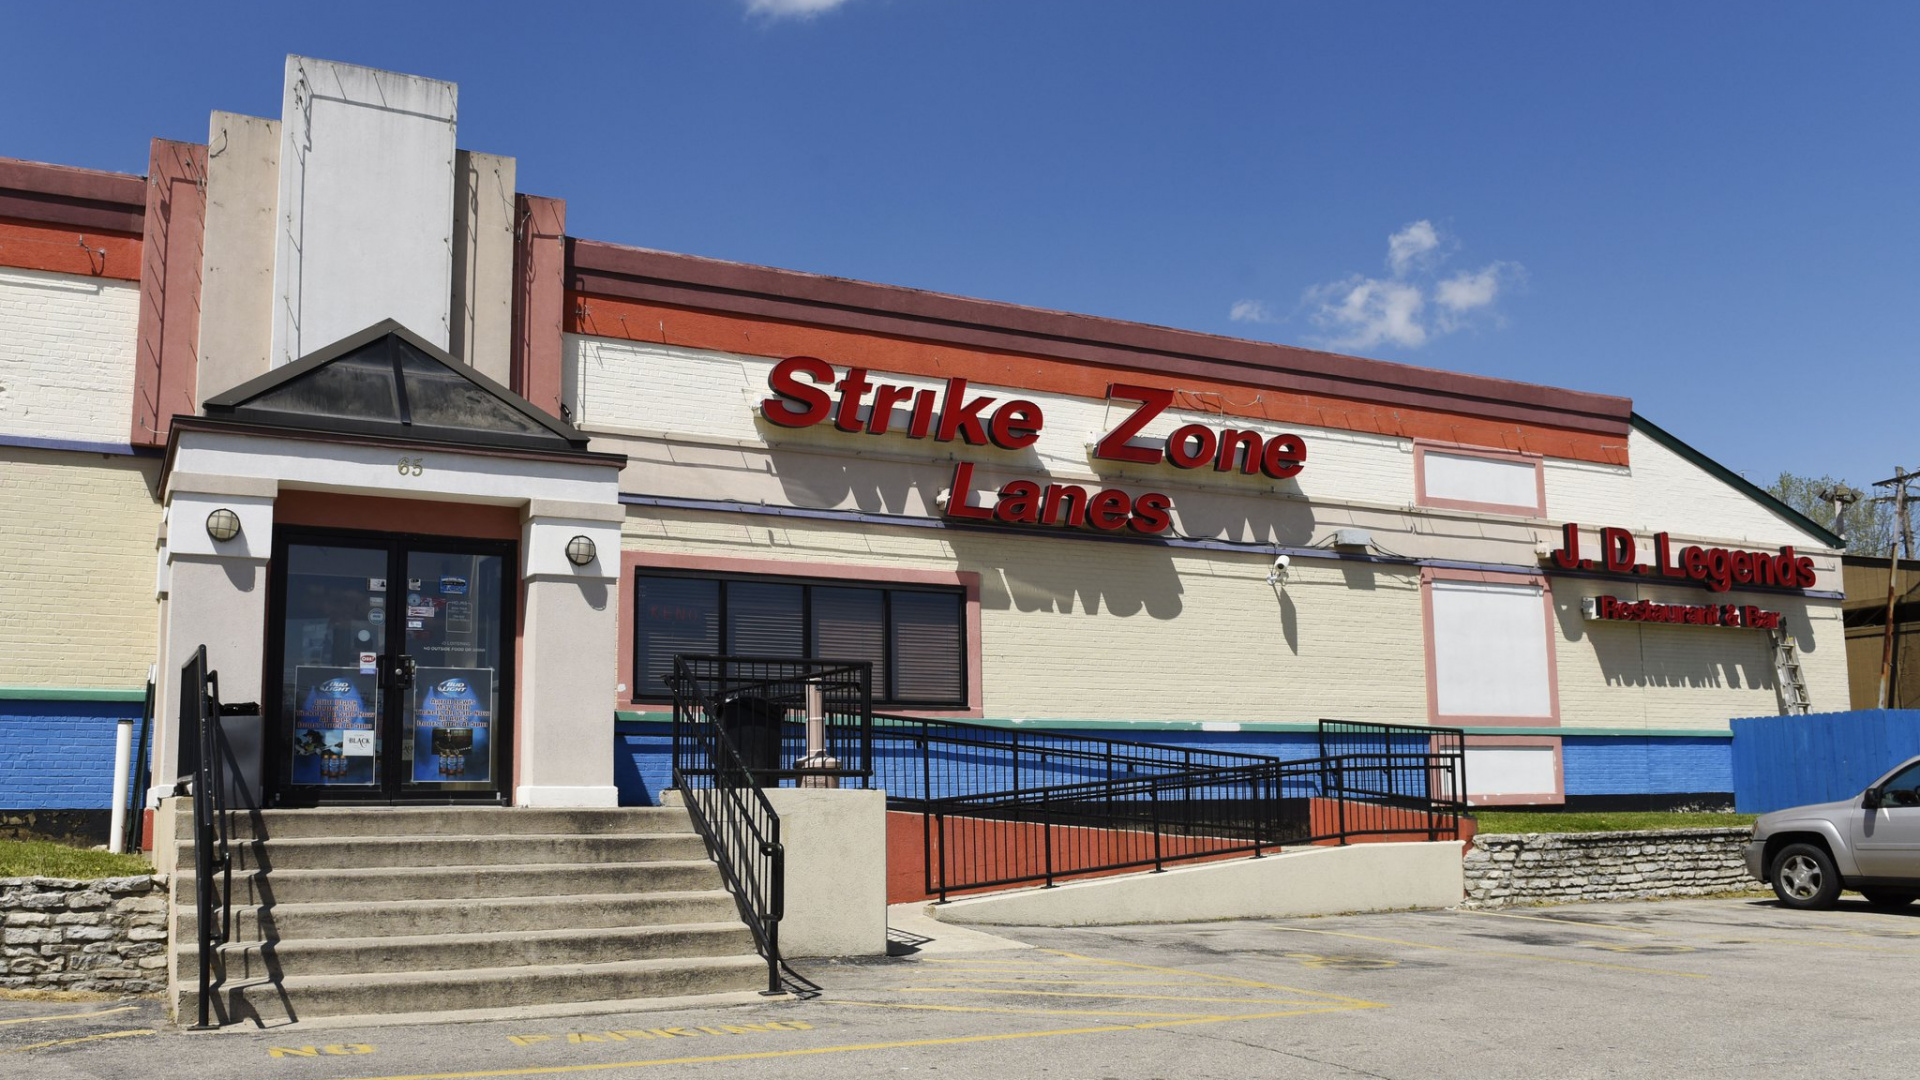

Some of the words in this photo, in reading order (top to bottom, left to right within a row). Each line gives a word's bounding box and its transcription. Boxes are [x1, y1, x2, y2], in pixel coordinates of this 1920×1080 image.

[760, 356, 1044, 450] Strike
[1096, 383, 1307, 480] Zone
[397, 457, 423, 477] 65
[946, 461, 1170, 534] Lanes
[1550, 522, 1593, 569] J.
[1601, 527, 1648, 575] D.
[1654, 531, 1816, 593] Legends
[1596, 595, 1719, 626] Restaurant
[1720, 603, 1740, 628] &
[1739, 604, 1780, 630] Bar
[349, 737, 370, 748] BLACK
[268, 1042, 374, 1058] NO
[506, 1020, 816, 1047] PARKING
